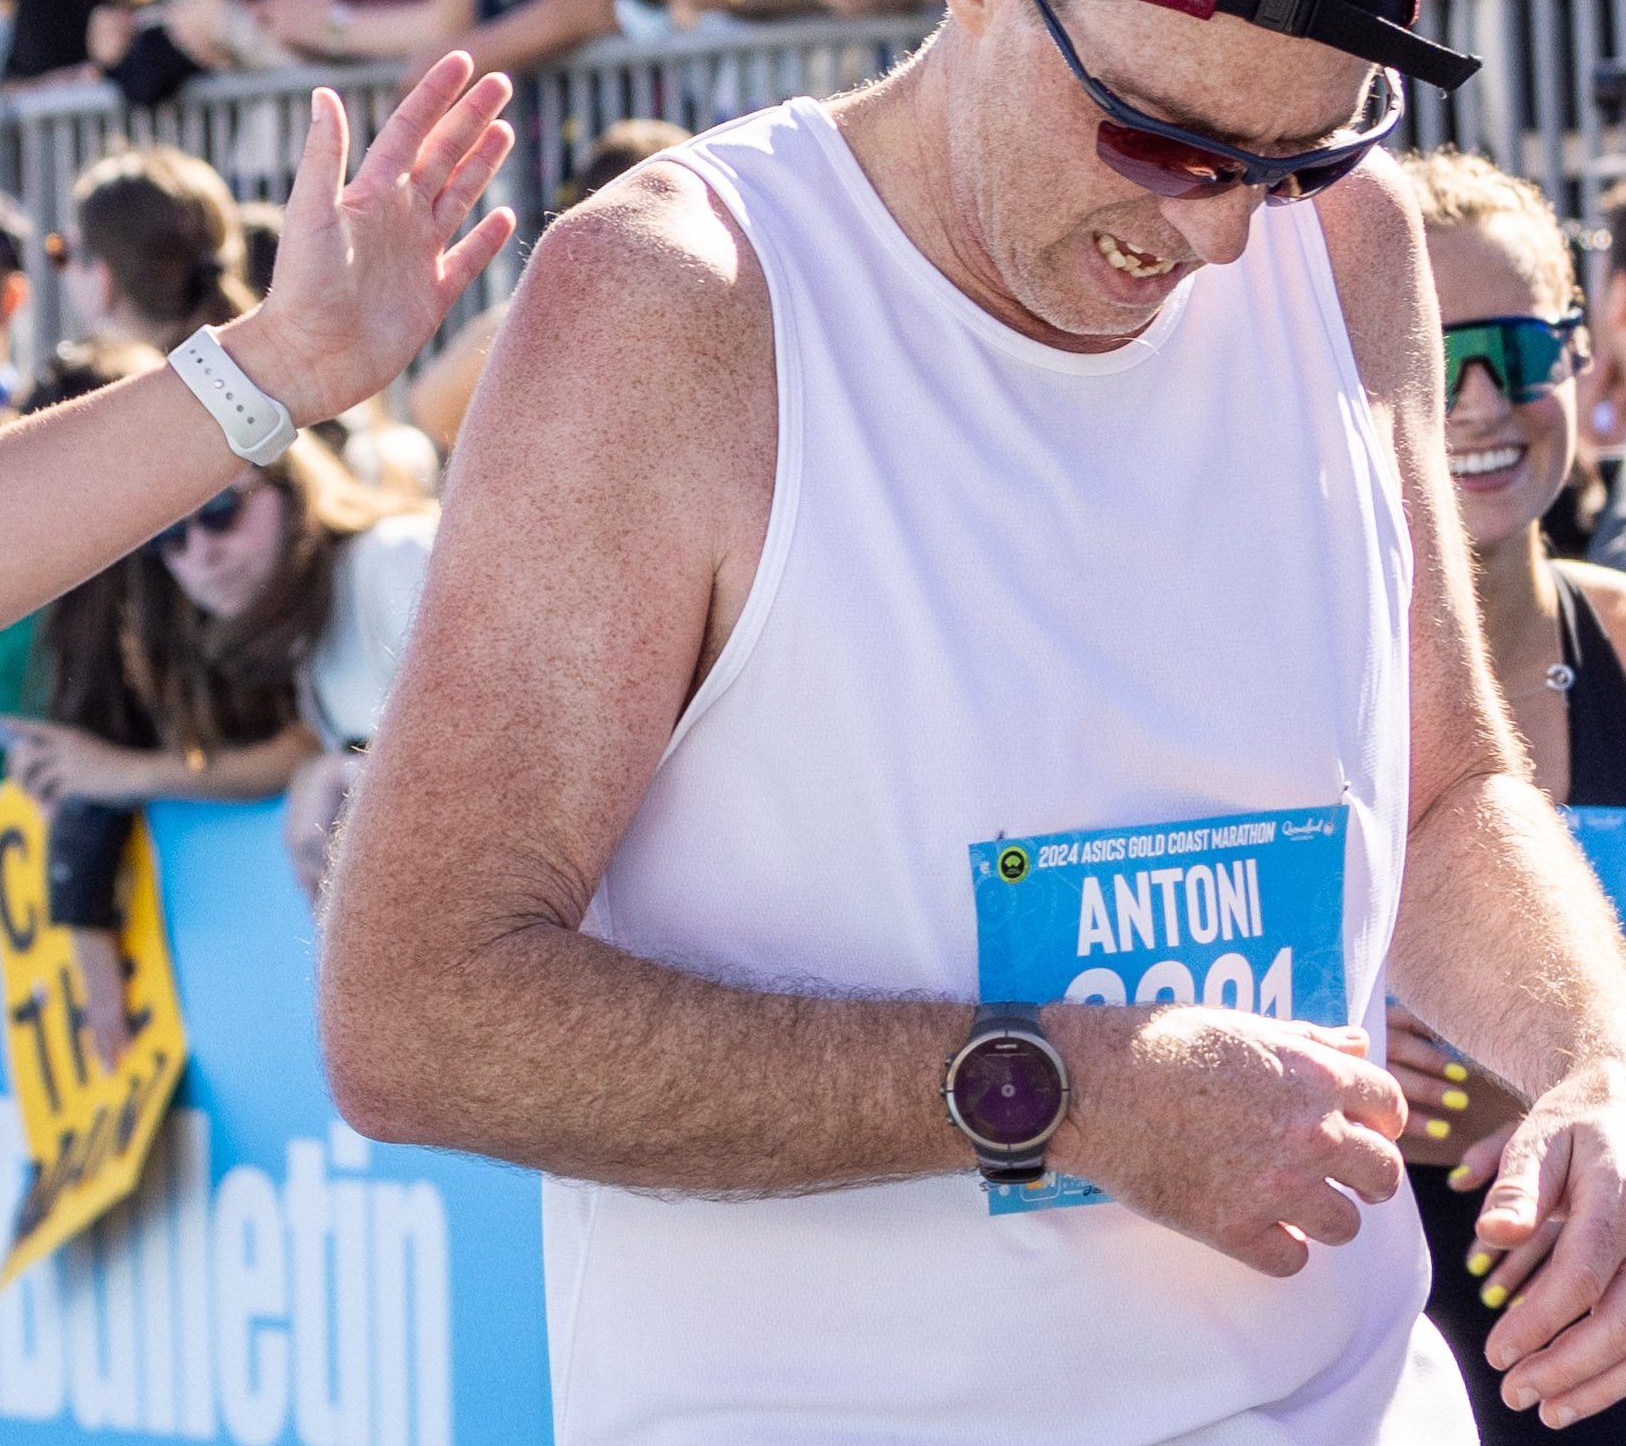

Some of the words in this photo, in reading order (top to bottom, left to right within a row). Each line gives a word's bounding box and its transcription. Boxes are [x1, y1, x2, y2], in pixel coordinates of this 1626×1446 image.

[1038, 844, 1079, 869] 2024
[1081, 839, 1125, 865] ASICS
[1128, 835, 1165, 859] GOLD
[1167, 829, 1210, 855] COAST
[1211, 821, 1276, 850] MARATHON
[1077, 858, 1263, 957] ANTONI
